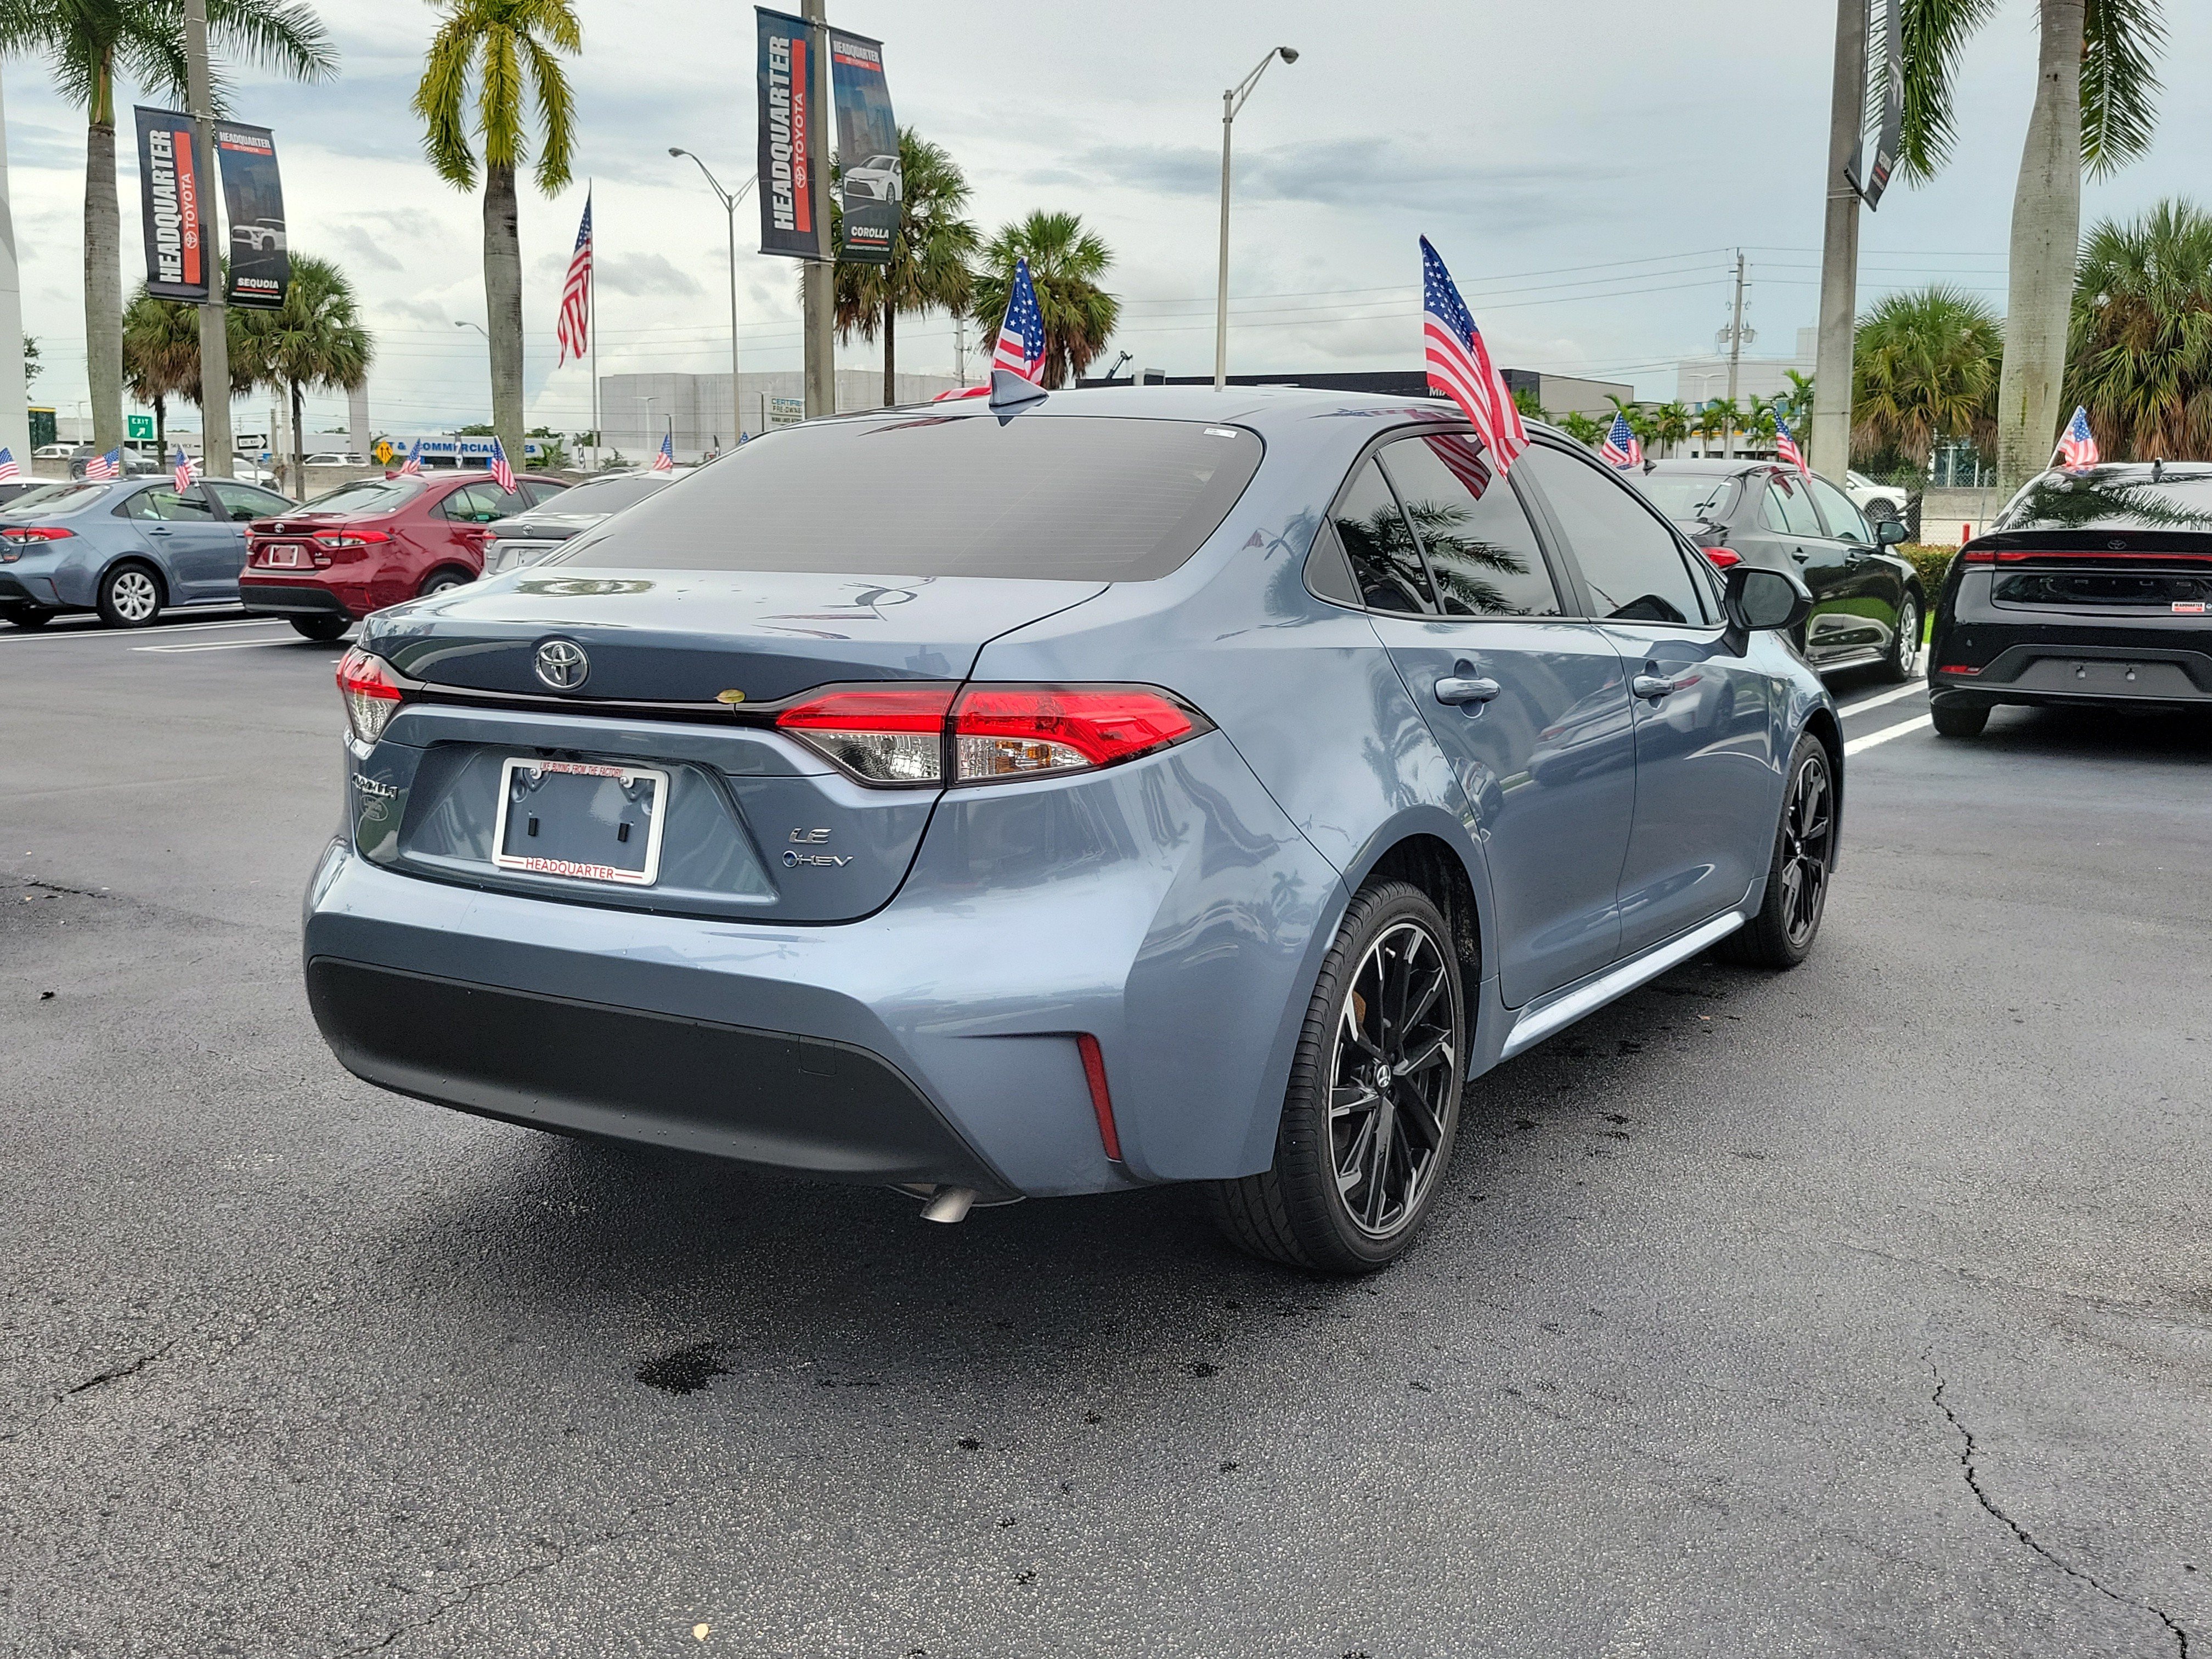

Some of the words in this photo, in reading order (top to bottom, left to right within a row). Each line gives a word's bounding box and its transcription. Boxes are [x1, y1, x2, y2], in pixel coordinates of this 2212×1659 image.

[833, 41, 880, 63] HEADQUARTER
[769, 36, 794, 230] HEADQUARTER
[794, 93, 804, 164] TOYOTA
[219, 132, 270, 149] HEADQUARTER
[150, 129, 182, 283] HEADQUARTER
[182, 173, 196, 229] TOYOTA
[851, 226, 889, 239] COROLLA
[238, 278, 279, 289] SEQUOIA
[540, 761, 550, 771] LIKE
[552, 763, 569, 772] BUYING
[572, 765, 586, 774] FROM
[589, 766, 598, 775] THE
[789, 828, 832, 844] LE
[526, 858, 614, 879] HEADQUARTER
